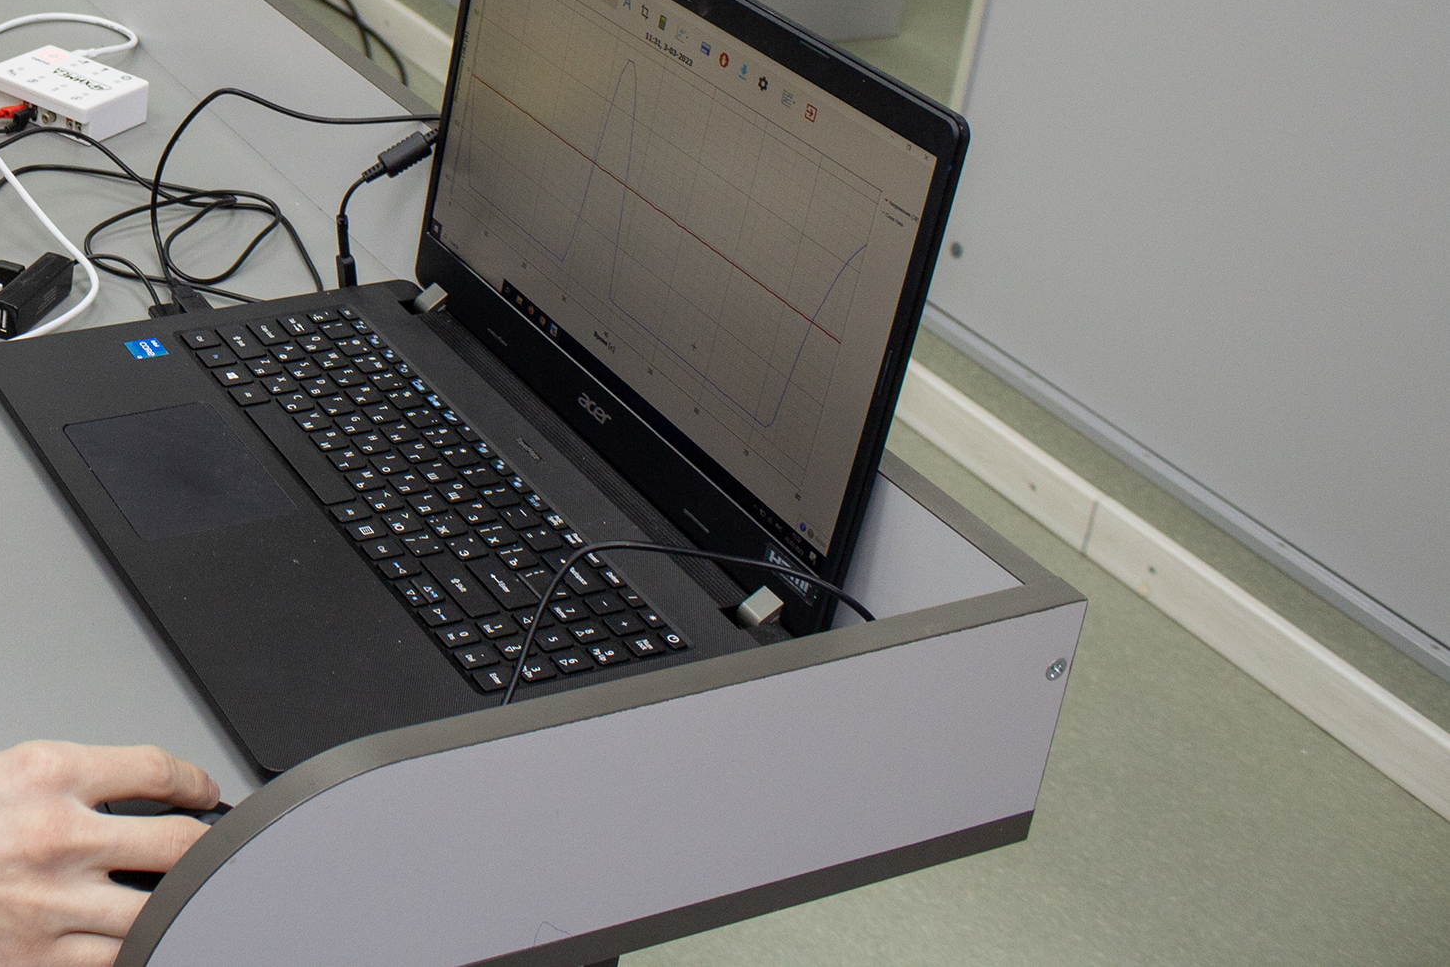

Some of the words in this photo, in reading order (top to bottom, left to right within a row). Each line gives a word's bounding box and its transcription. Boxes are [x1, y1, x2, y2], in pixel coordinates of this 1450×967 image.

[645, 32, 663, 49] 11:31,
[663, 43, 693, 66] 3-03-2023
[577, 392, 612, 425] acer
[448, 492, 460, 500] Щ
[392, 522, 405, 531] Ю
[436, 525, 450, 534] Ж
